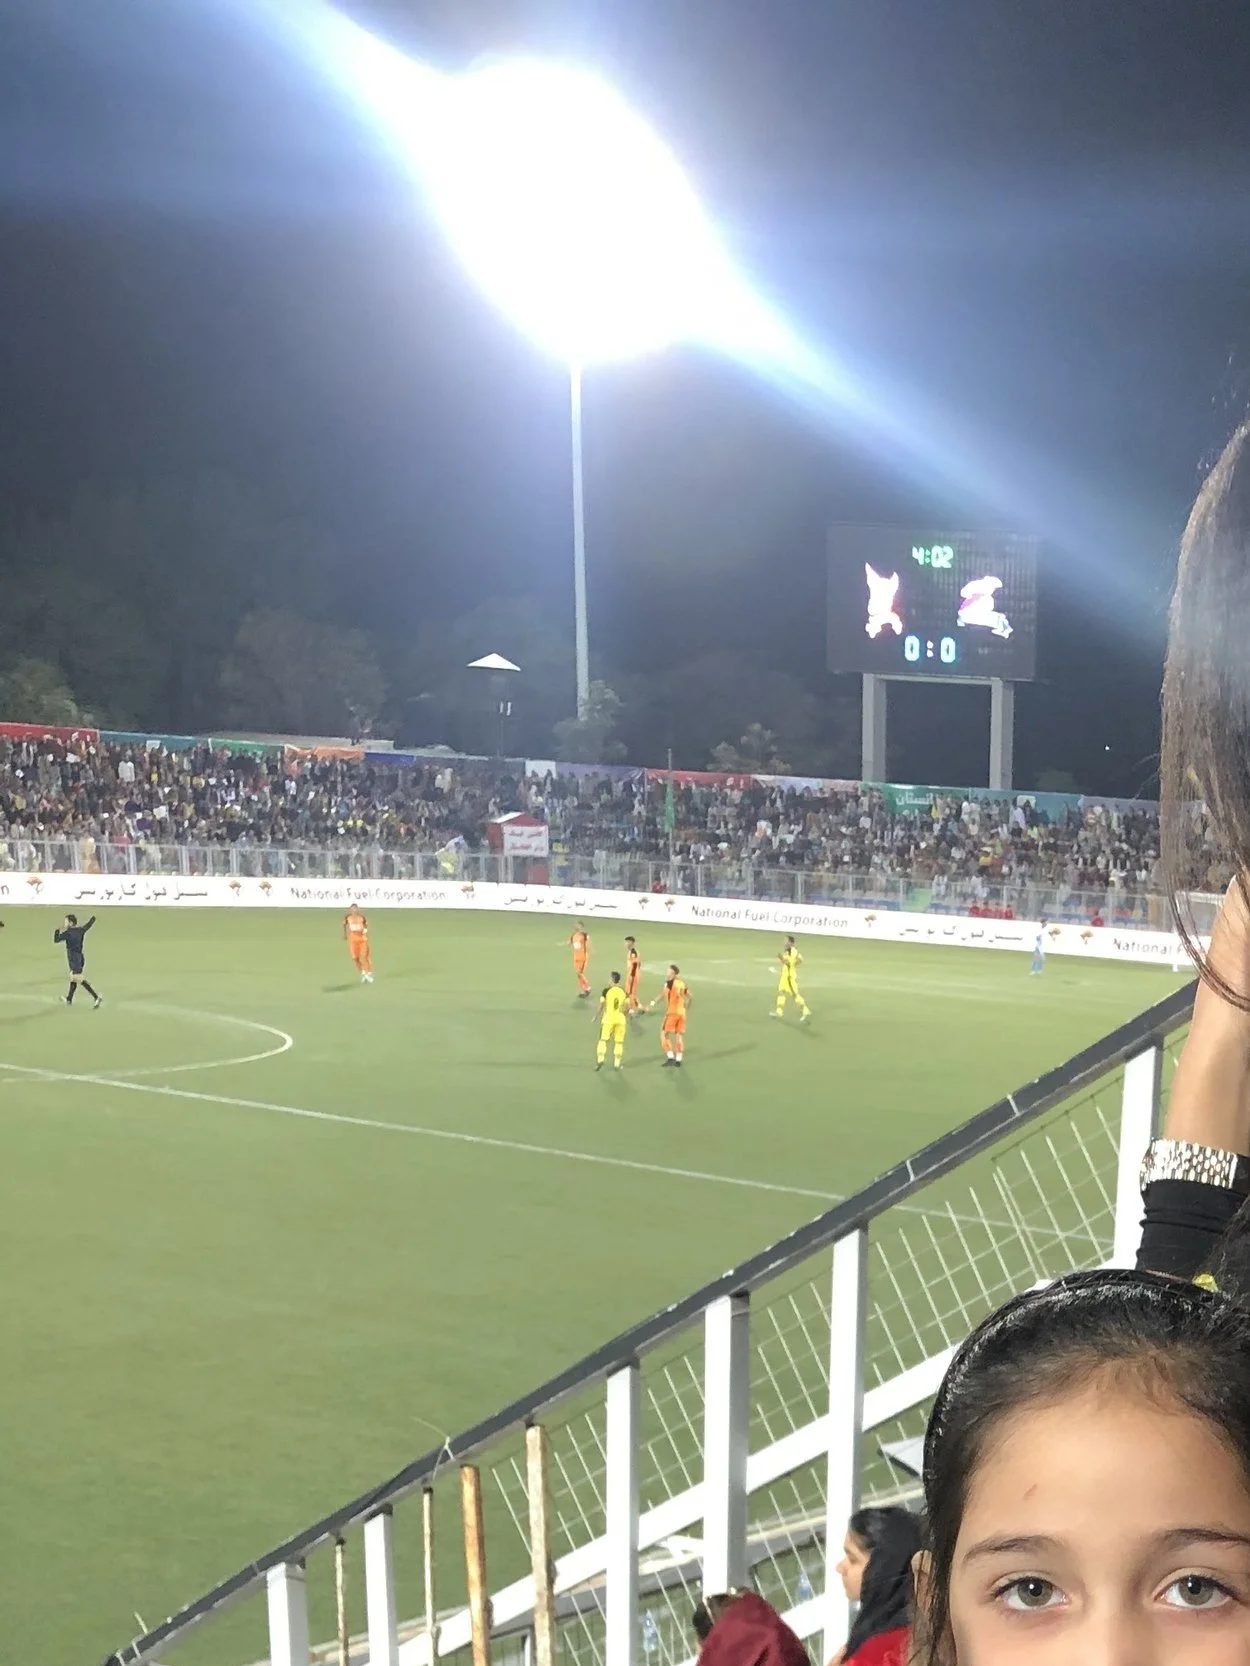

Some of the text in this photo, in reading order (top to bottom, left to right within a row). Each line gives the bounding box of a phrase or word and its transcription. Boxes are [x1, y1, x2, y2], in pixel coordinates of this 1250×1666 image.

[912, 545, 954, 568] 4:02
[290, 887, 446, 902] National Fuel Corporation
[691, 905, 849, 929] National Fuel Corporation
[1113, 937, 1173, 955] National
